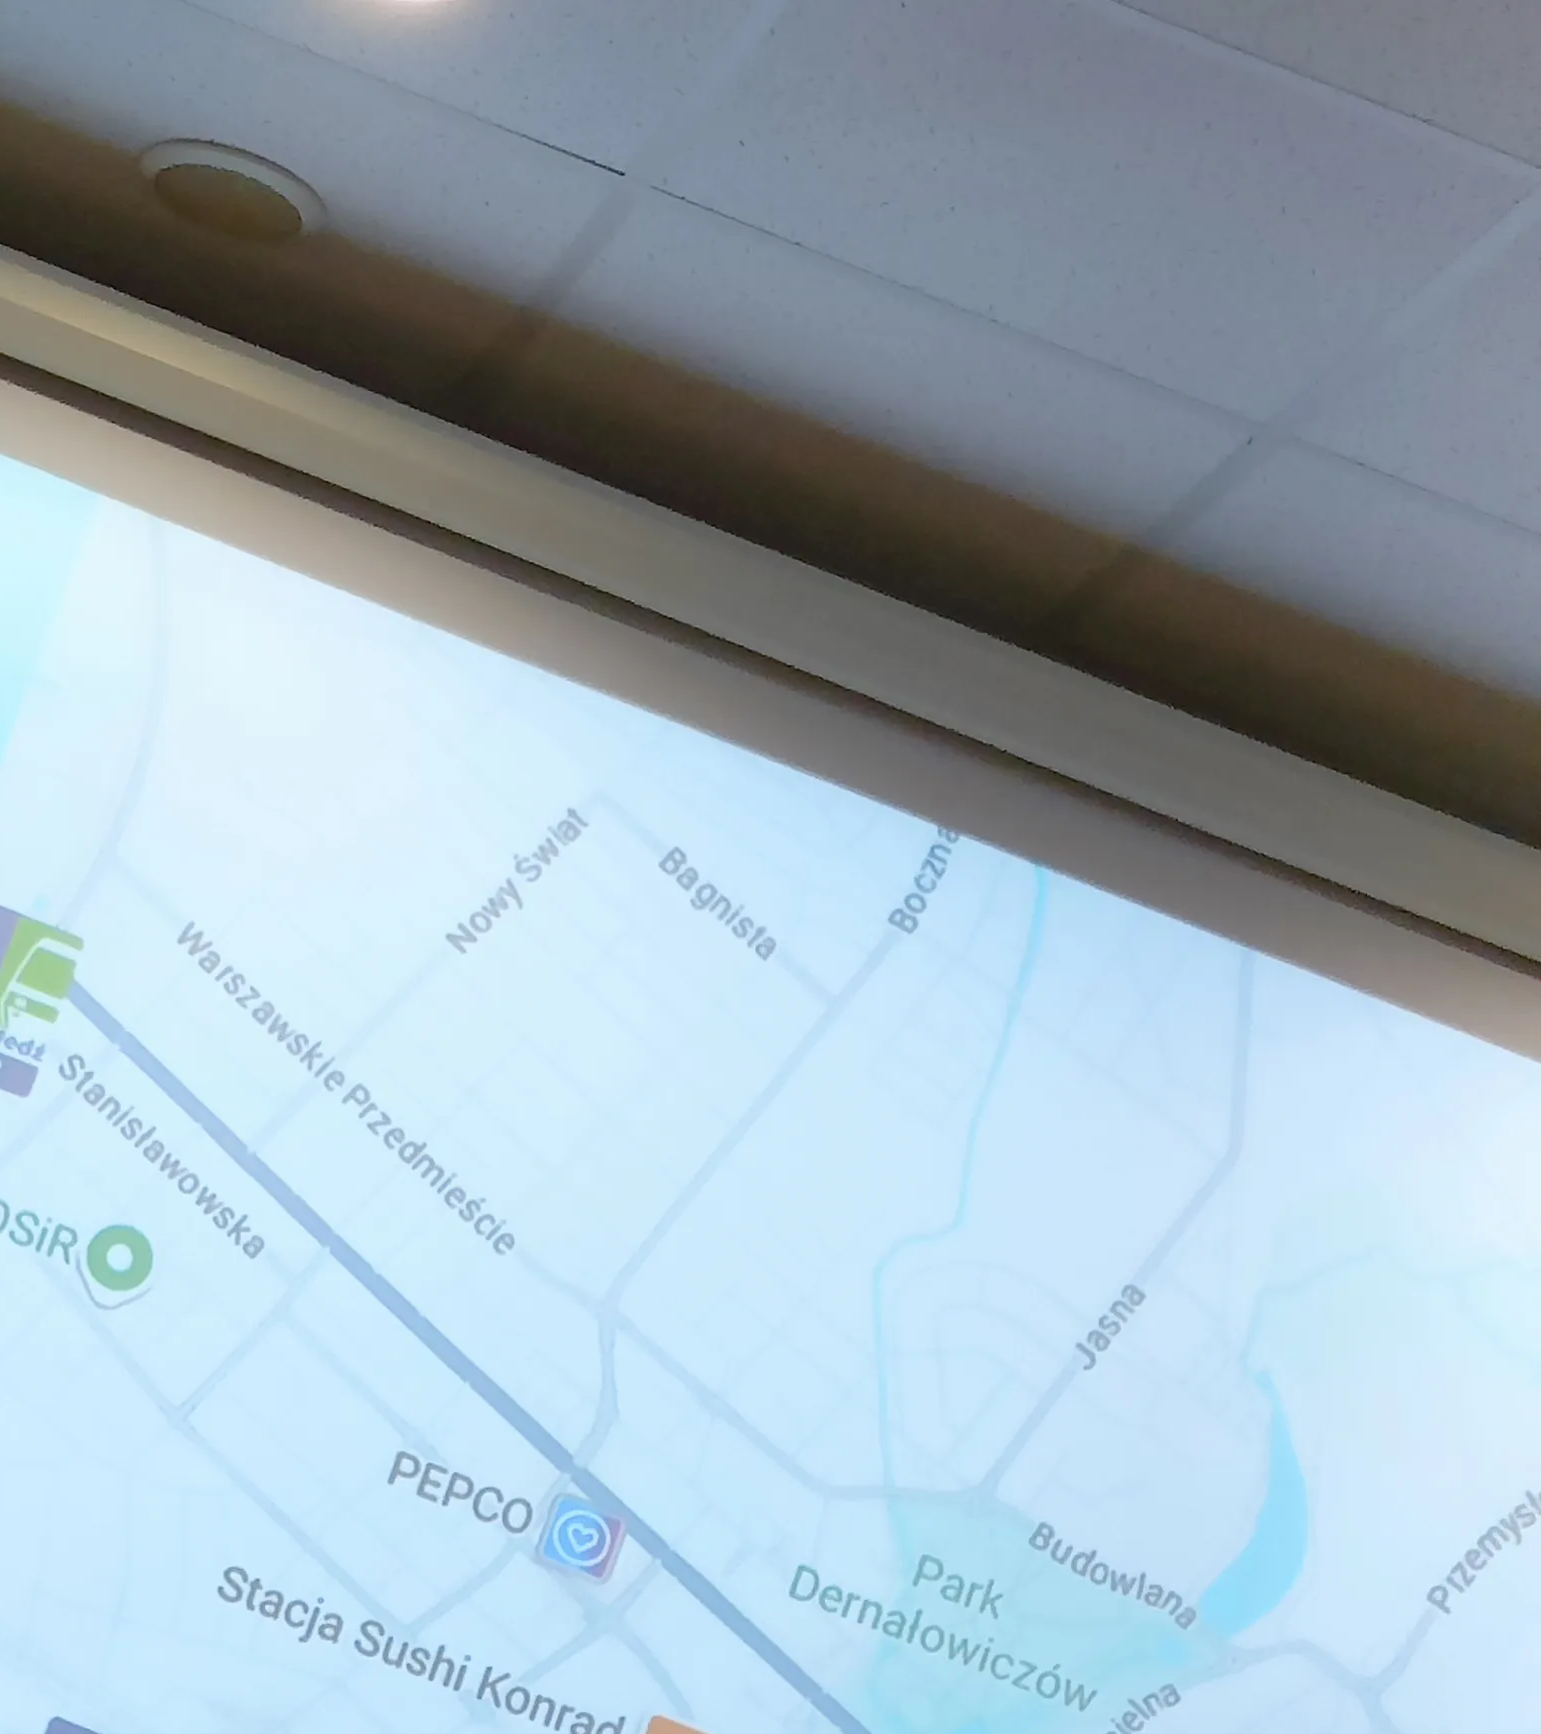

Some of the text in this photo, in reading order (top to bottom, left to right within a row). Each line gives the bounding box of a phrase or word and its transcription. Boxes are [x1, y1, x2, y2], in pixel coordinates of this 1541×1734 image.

[445, 807, 589, 955] Nowy Świat
[659, 846, 777, 961] Bagnista
[176, 922, 516, 1256] Warszawskie Przedmieście
[58, 1054, 266, 1260] Stanisławowska
[1076, 1281, 1147, 1371] Jasna
[388, 1452, 533, 1533] PEPCO
[218, 1566, 343, 1644] Stacja
[354, 1621, 472, 1692] Sushi
[912, 1554, 1004, 1619] Park
[1028, 1523, 1198, 1630] Budowlana
[789, 1565, 1098, 1711] Dernałowiczów
